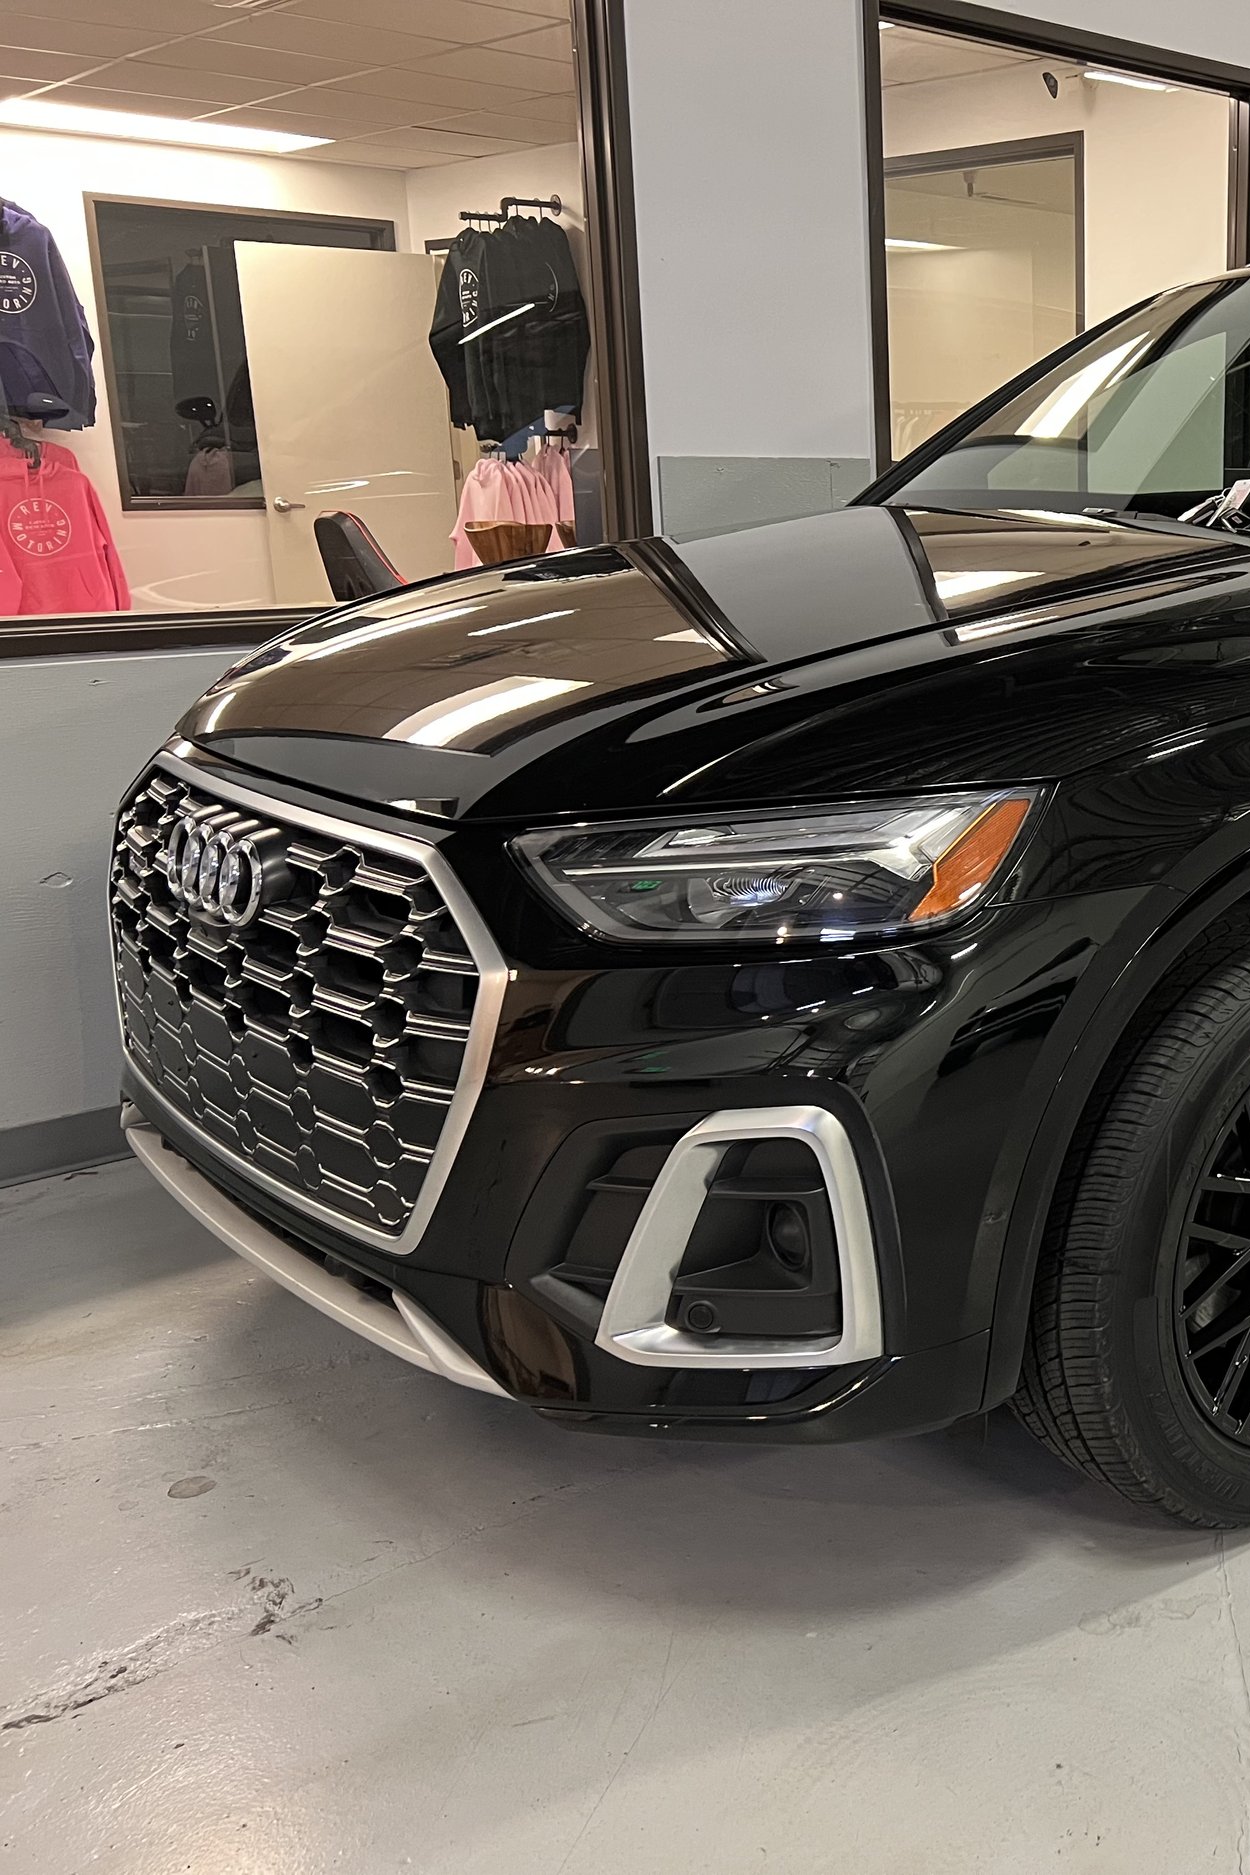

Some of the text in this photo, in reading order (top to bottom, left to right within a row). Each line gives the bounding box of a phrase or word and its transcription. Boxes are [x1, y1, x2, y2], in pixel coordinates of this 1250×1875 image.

[0, 255, 20, 269] EV
[19, 501, 52, 515] REV
[11, 519, 67, 552] MOTORING
